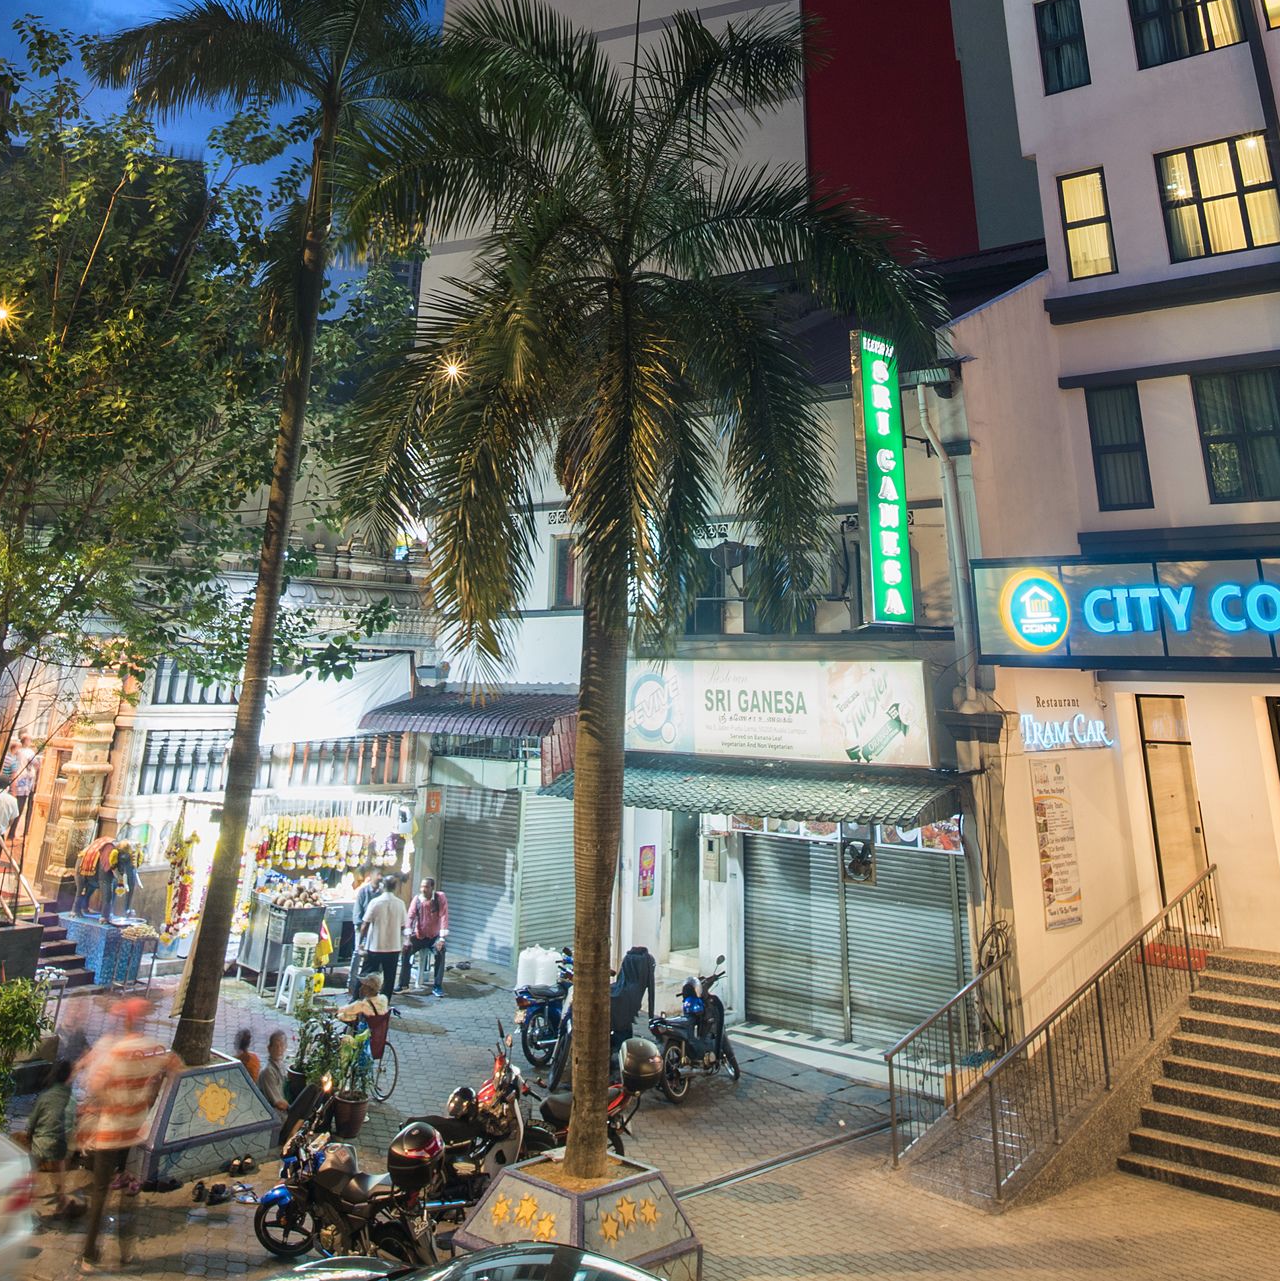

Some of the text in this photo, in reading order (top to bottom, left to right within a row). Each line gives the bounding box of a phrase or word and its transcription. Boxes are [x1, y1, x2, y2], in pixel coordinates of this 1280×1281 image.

[870, 359, 907, 615] SRI GANESA
[1082, 584, 1195, 634] CITY
[704, 688, 808, 715] SRI GANESA
[1035, 695, 1080, 708] Restaurant
[721, 741, 746, 749] Vegetarian
[768, 743, 794, 751] Vegetarian
